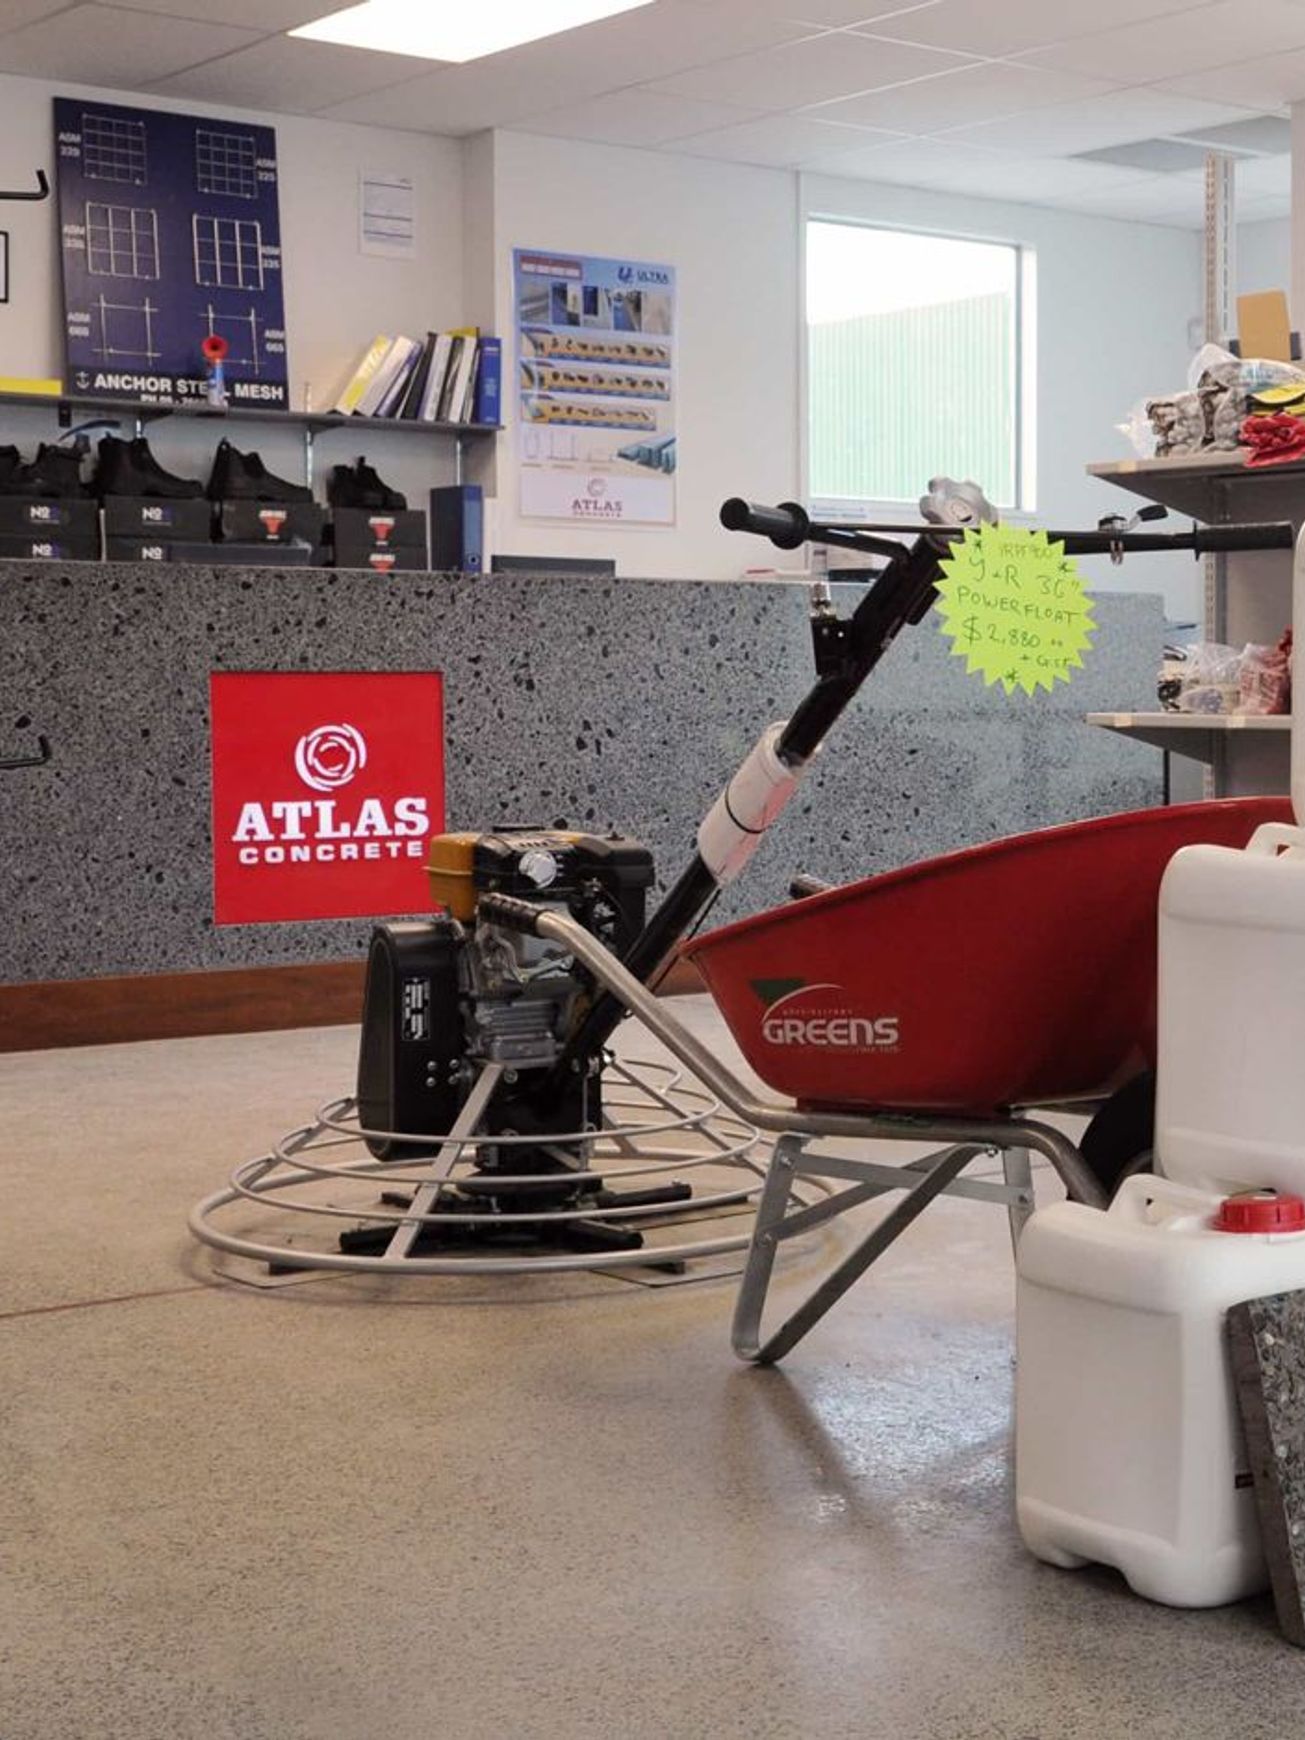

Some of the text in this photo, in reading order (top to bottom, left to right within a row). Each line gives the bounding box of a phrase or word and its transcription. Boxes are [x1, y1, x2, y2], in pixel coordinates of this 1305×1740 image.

[94, 373, 284, 401] ANCHOR STE MESH
[571, 499, 623, 512] ATLAS
[231, 797, 431, 842] ATLAS
[239, 840, 424, 865] CONCRETE
[762, 1017, 899, 1046] GREENS
